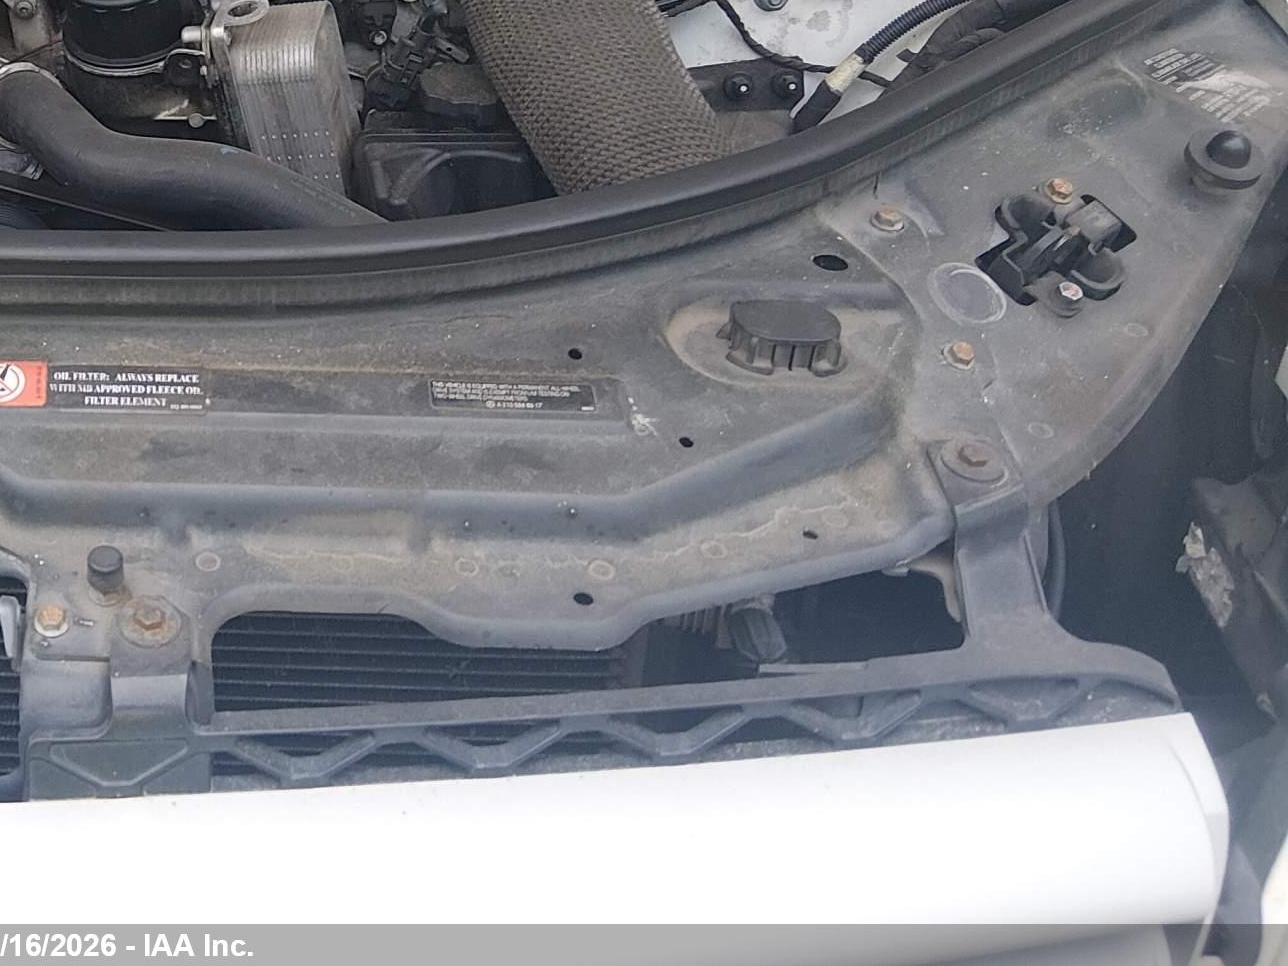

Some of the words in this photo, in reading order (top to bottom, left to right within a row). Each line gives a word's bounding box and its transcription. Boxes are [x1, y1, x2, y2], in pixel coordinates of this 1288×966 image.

[53, 372, 72, 381] OIL
[73, 372, 110, 382] FILTER:
[114, 373, 153, 383] ALWAYS
[154, 374, 200, 384] REPLACE
[49, 383, 76, 393] WITH
[76, 384, 93, 393] MB
[95, 384, 146, 394] APPROVED
[146, 385, 184, 395] FLEECE
[84, 396, 120, 406] FILTER
[120, 397, 167, 407] ELEMENT
